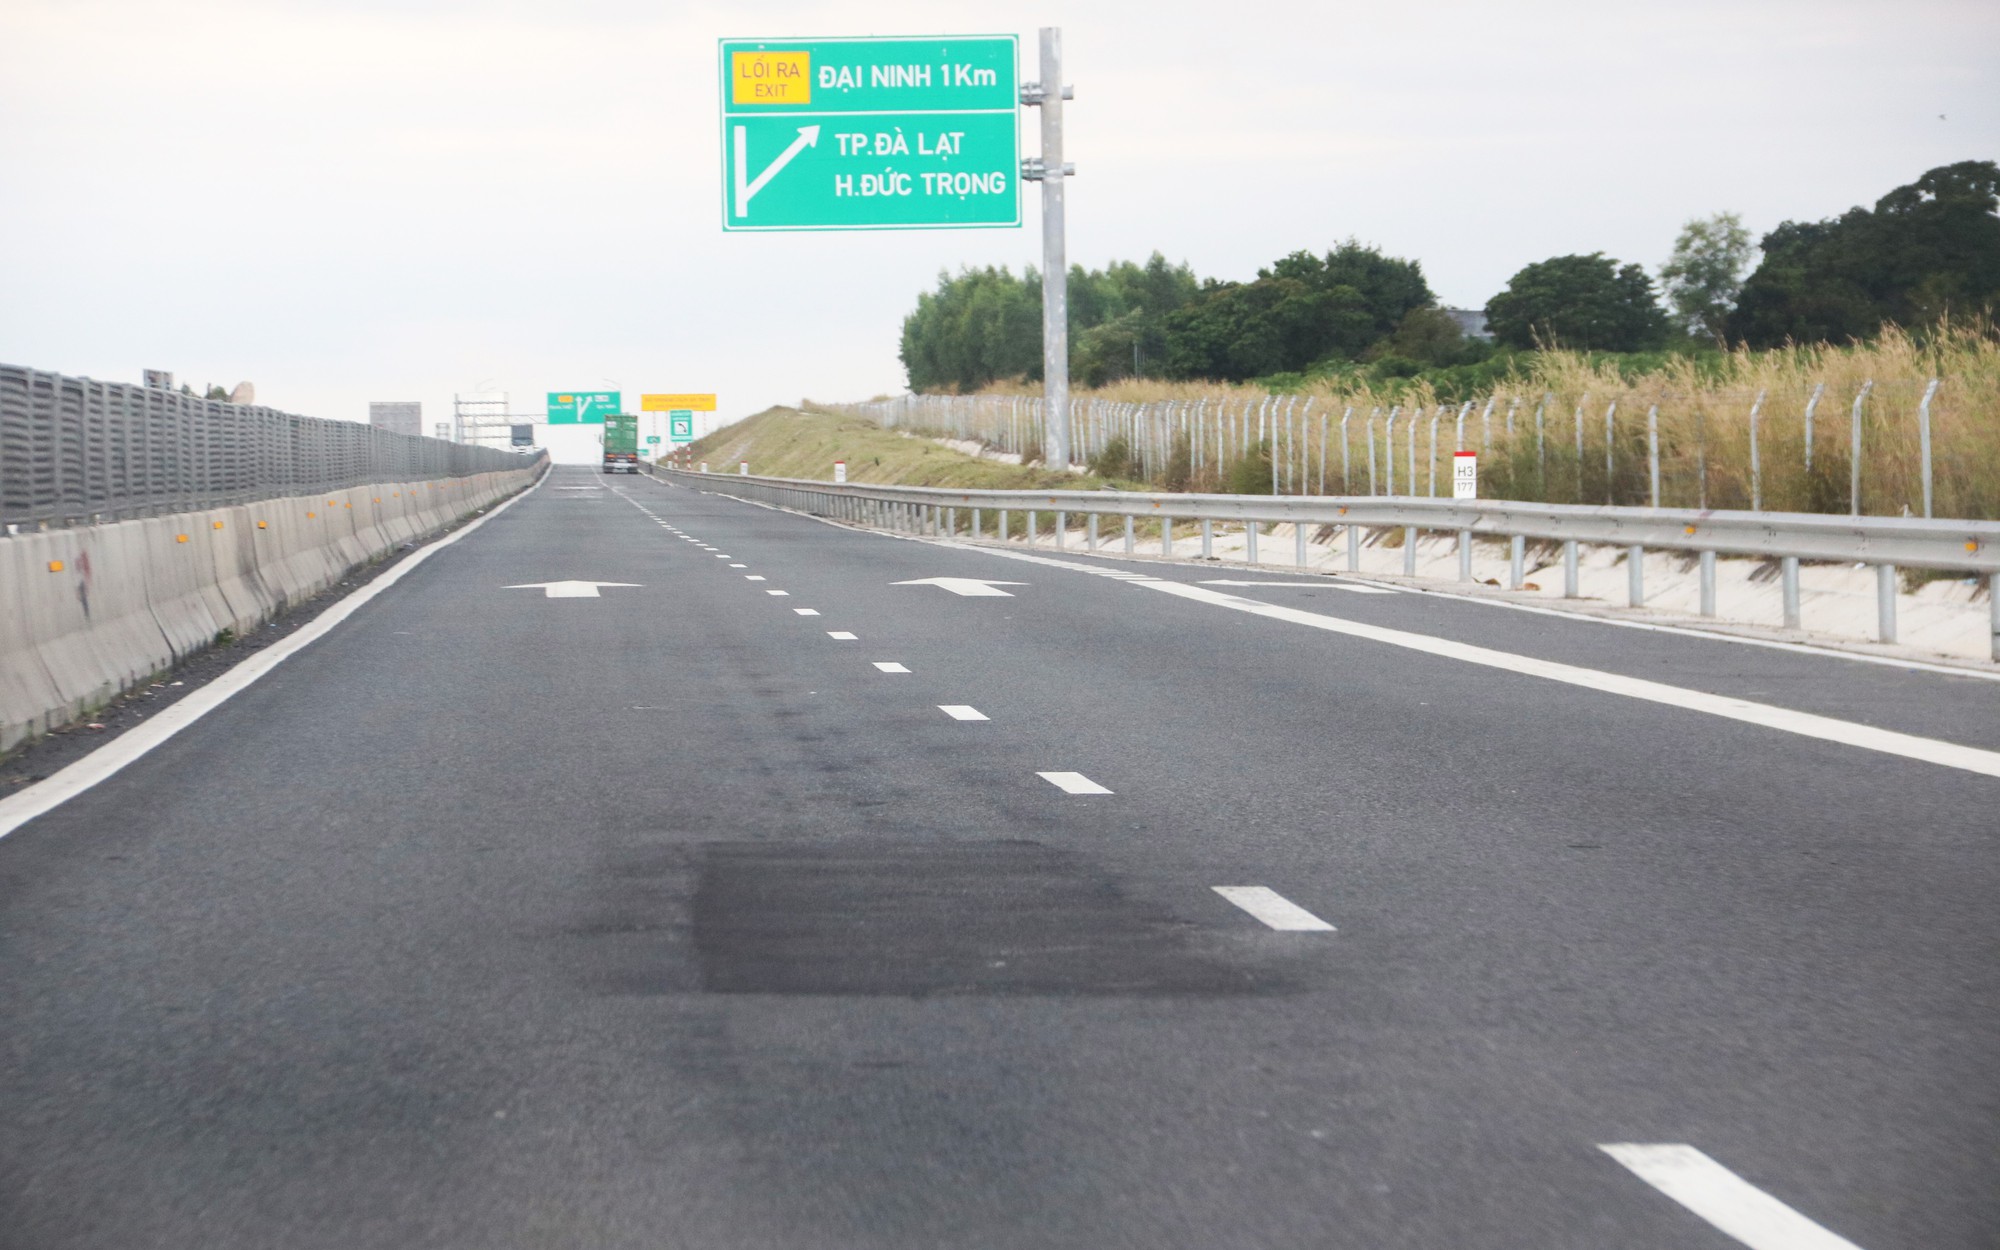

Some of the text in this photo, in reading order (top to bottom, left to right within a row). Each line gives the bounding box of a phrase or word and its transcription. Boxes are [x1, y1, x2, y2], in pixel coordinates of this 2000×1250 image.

[742, 54, 801, 78] LỐI RA
[755, 83, 788, 97] EXIT
[818, 64, 863, 93] ĐẠI
[871, 64, 931, 88] NINH
[834, 126, 965, 161] TP.ĐÀ LẠT
[835, 166, 1006, 201] H.ĐỨC TRỌNG
[1457, 465, 1474, 477] H3
[1457, 481, 1474, 492] 177
